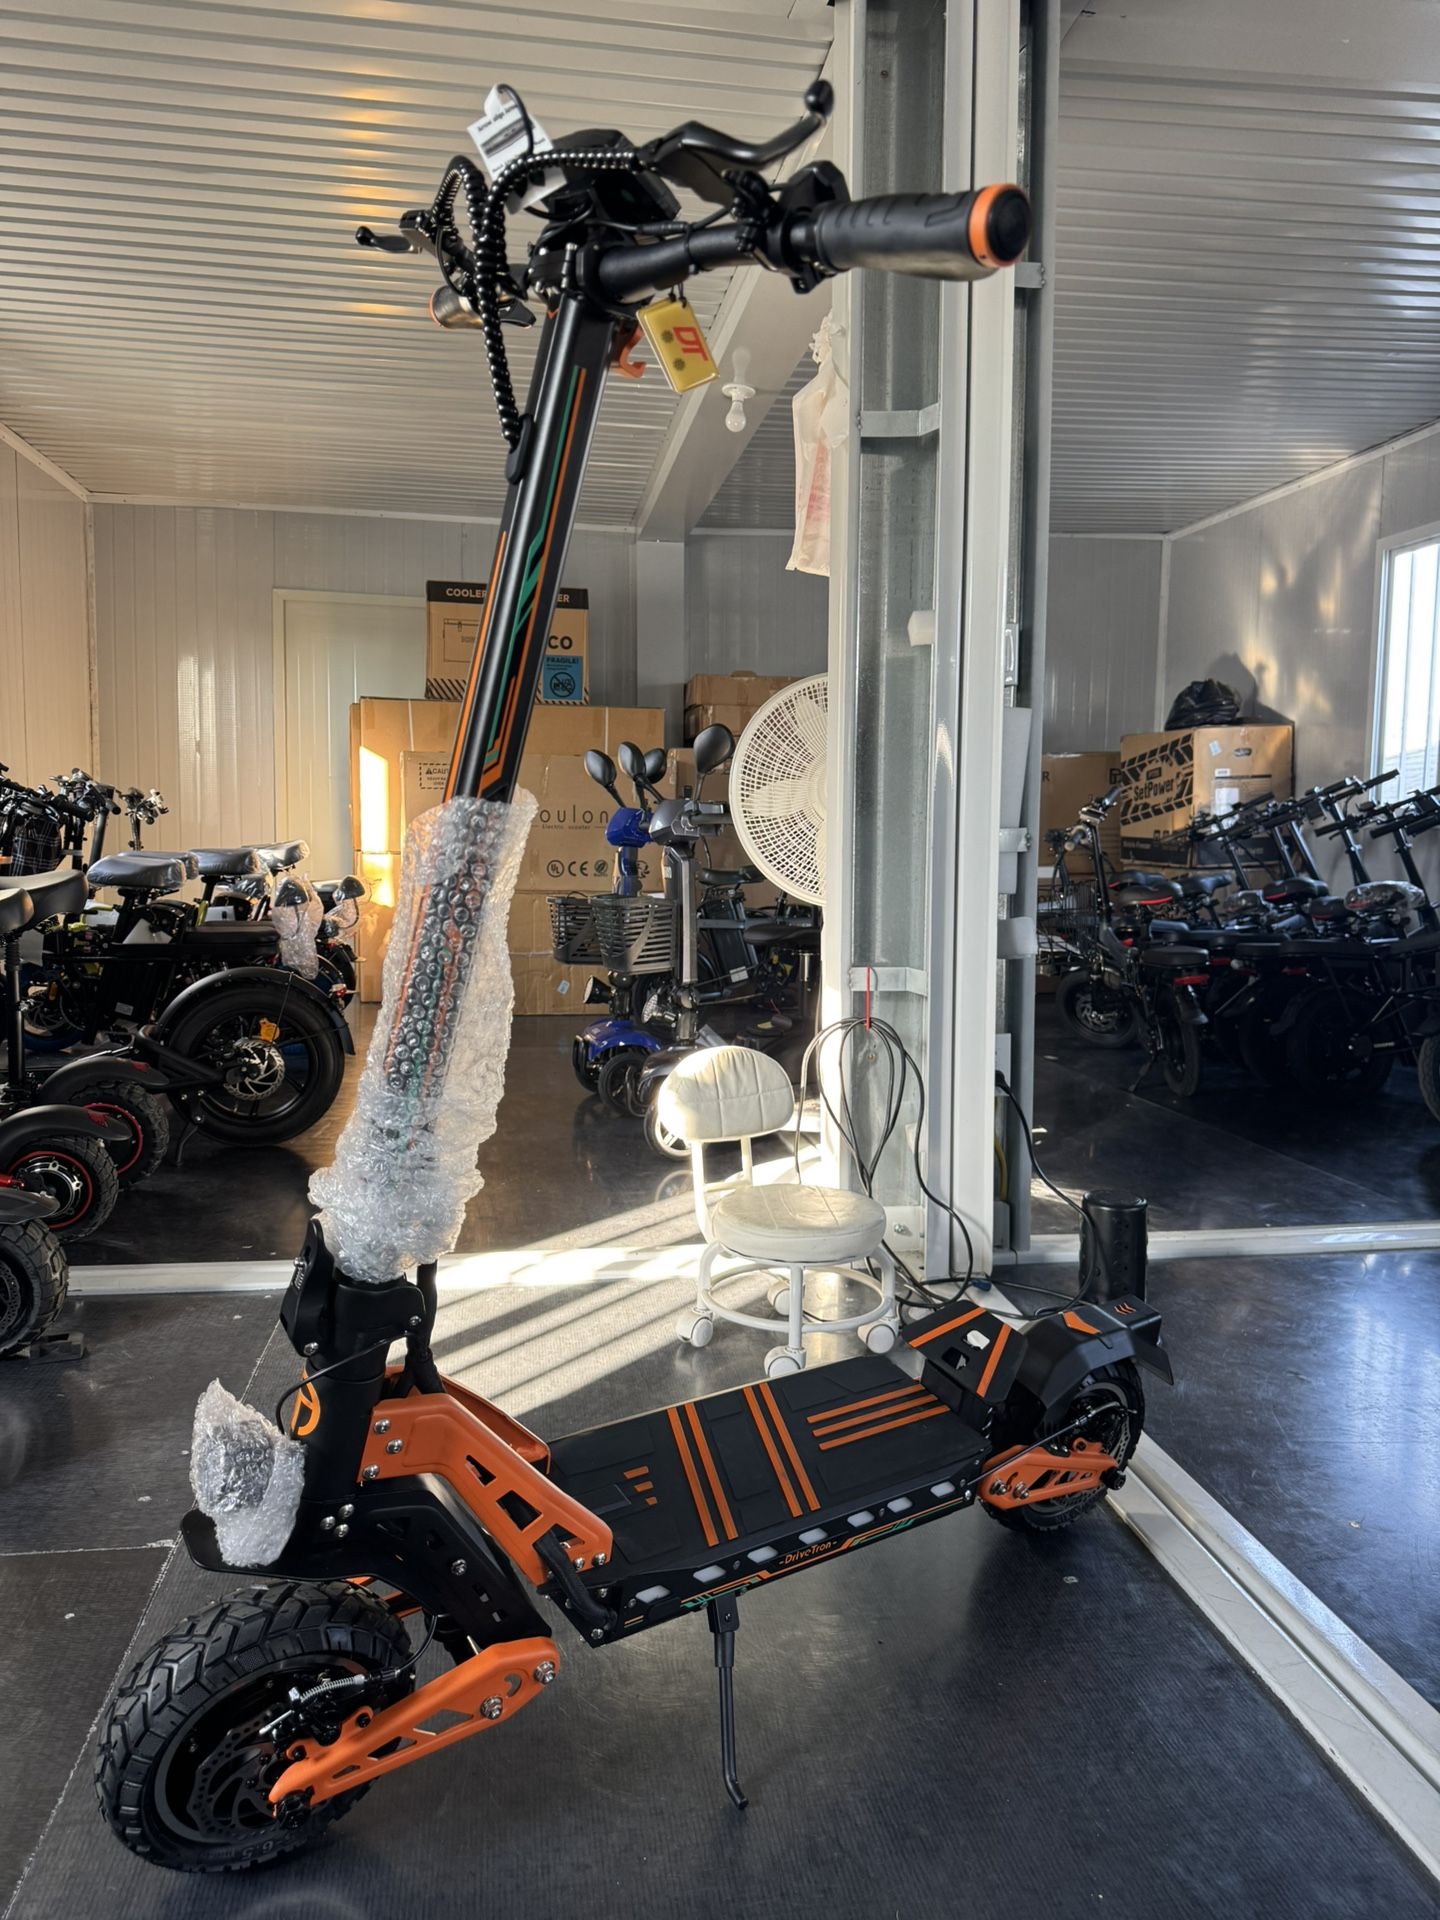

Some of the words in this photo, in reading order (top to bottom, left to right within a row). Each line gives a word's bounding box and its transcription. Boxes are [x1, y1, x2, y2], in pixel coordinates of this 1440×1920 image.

[548, 635, 573, 650] CO
[1134, 777, 1174, 801] SetPower
[540, 805, 608, 824] oulon
